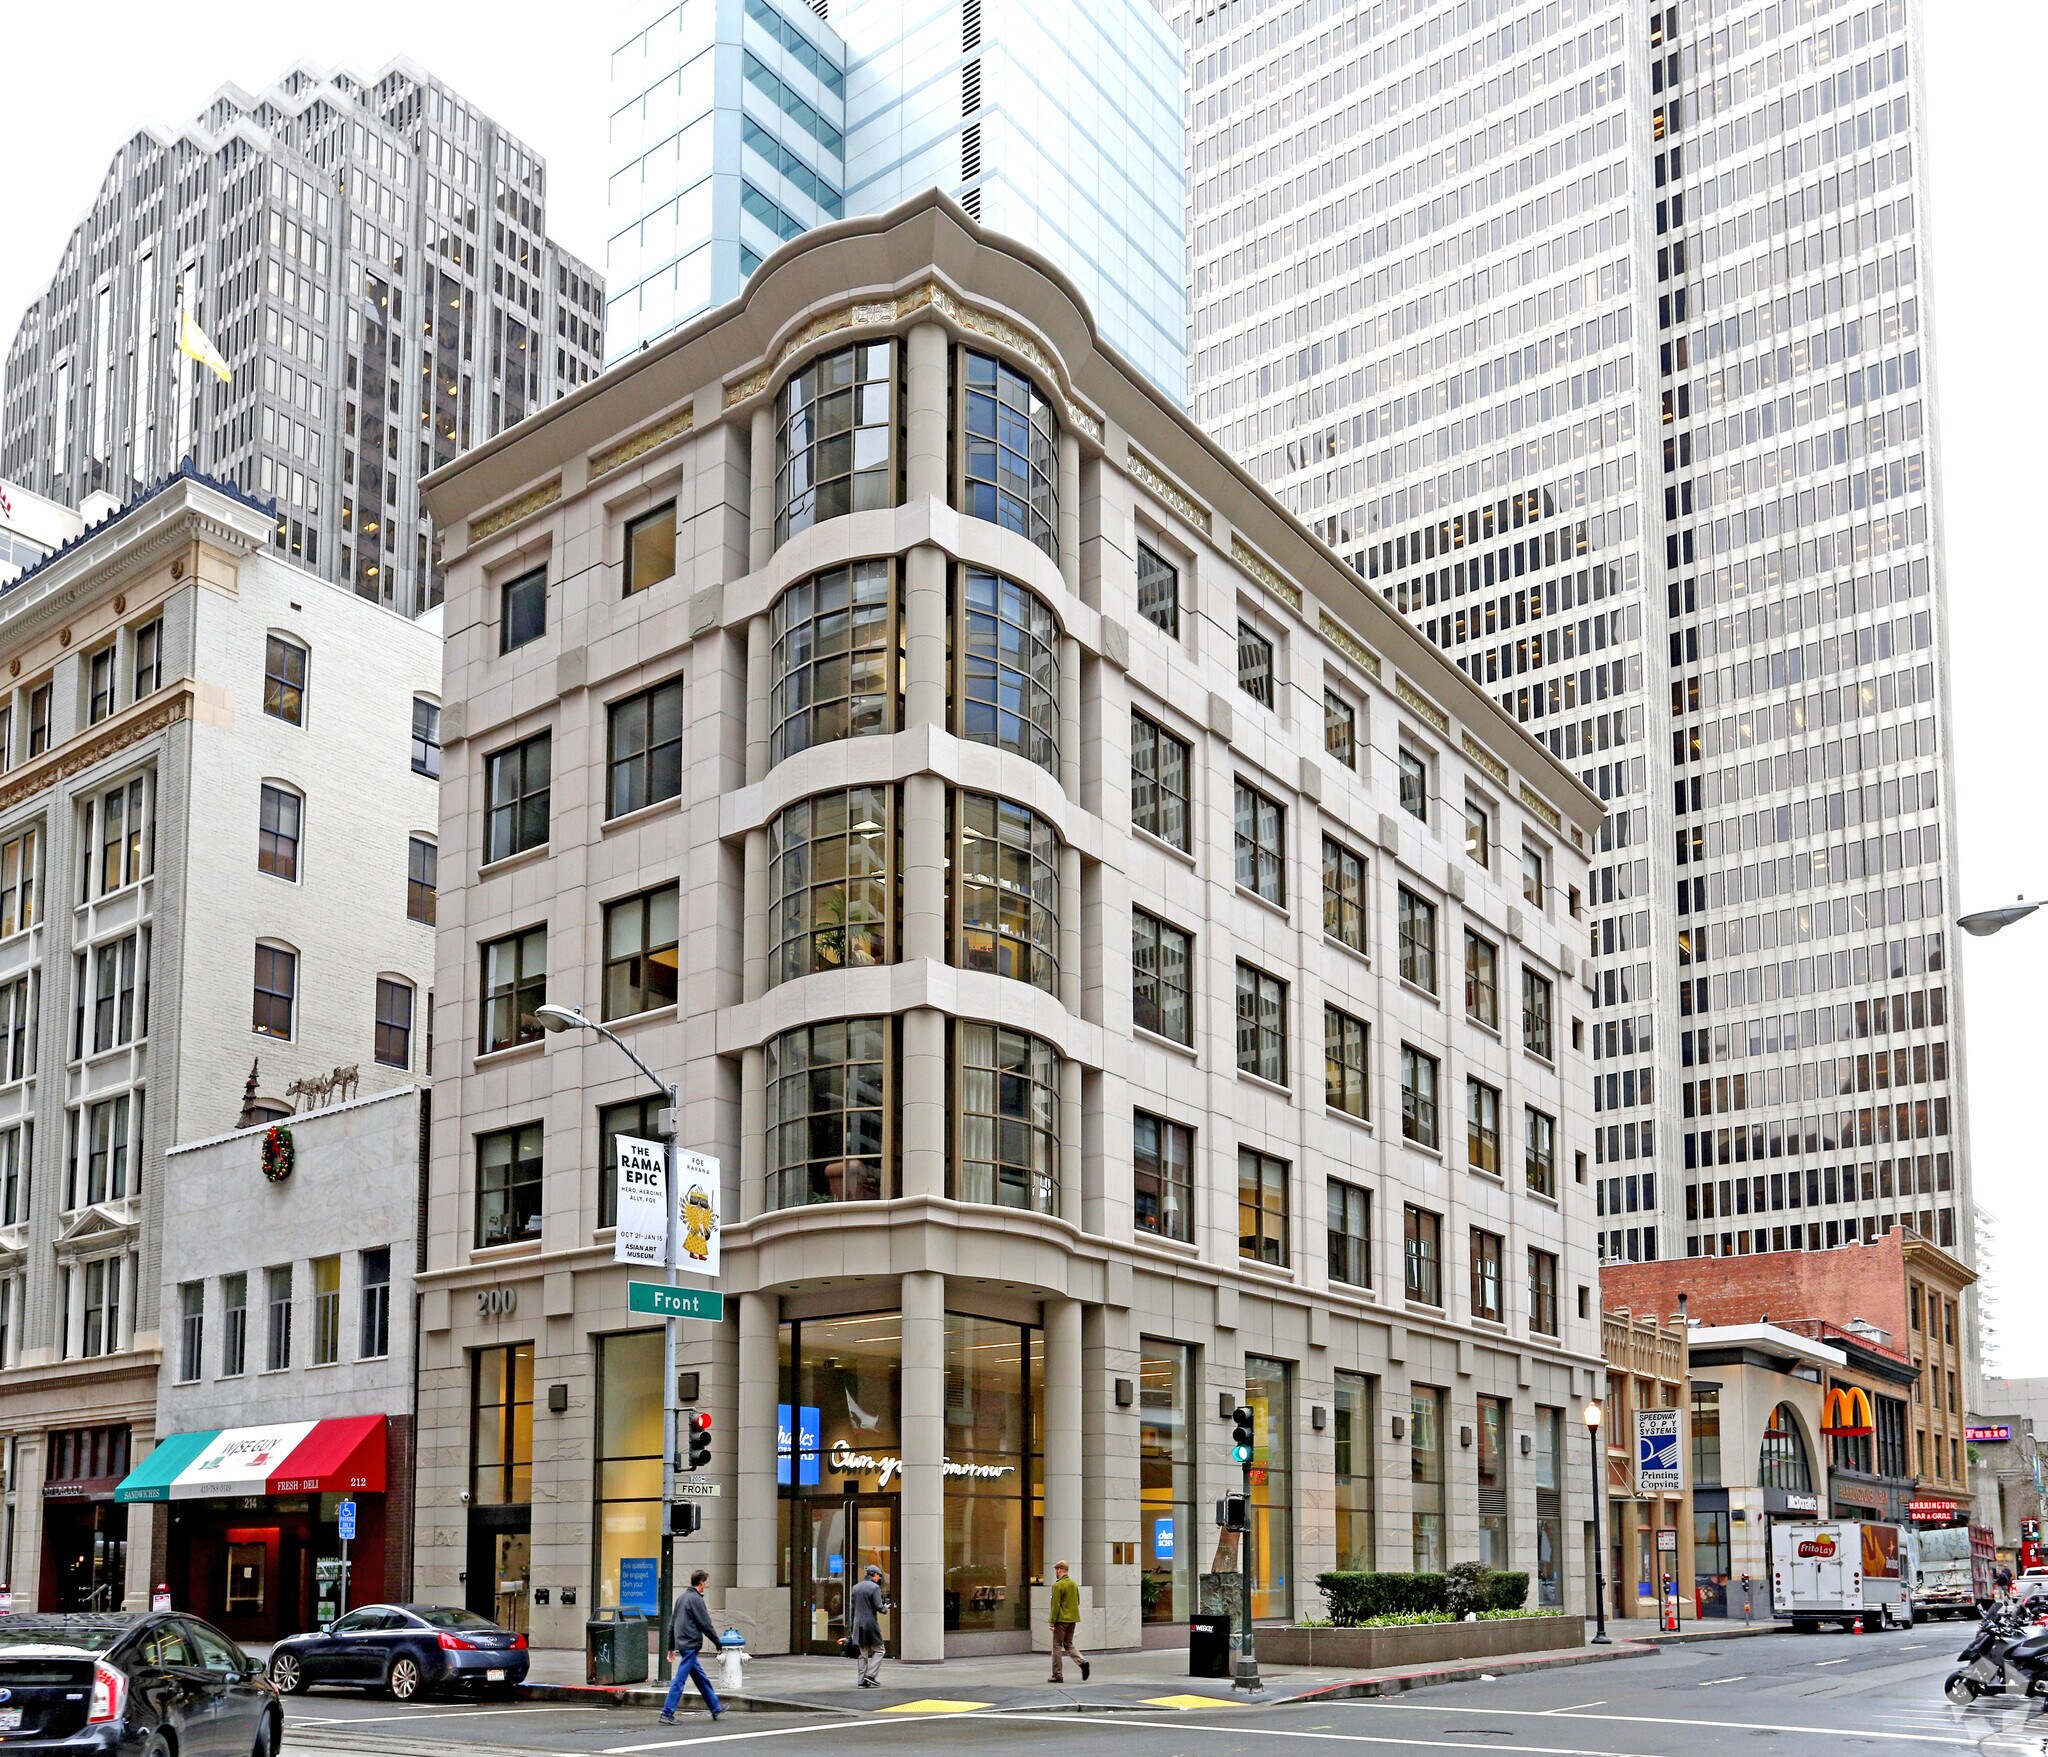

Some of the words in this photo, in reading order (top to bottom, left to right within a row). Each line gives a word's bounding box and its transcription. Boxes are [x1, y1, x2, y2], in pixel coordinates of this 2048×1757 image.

[631, 1145, 650, 1157] THE
[621, 1155, 662, 1173] RAMA
[692, 1157, 704, 1167] FOE
[687, 1165, 710, 1175] RAVANA
[626, 1170, 658, 1187] EPIC
[630, 1195, 645, 1203] ALLY,
[645, 1196, 656, 1204] FOE
[625, 1243, 644, 1252] ASIAN
[645, 1245, 657, 1253] ART
[627, 1251, 654, 1260] MUSEUM
[476, 1288, 517, 1316] 200
[654, 1291, 699, 1312] Front
[1639, 1412, 1677, 1421] SPEEDWAY
[1639, 1420, 1677, 1428] COPY
[1640, 1427, 1677, 1436] SYSTEMS
[1641, 1471, 1679, 1480] Printing
[277, 1480, 298, 1491] FRESH
[303, 1479, 319, 1489] DELI
[350, 1477, 366, 1487] 212
[1641, 1480, 1679, 1490] Copying
[124, 1488, 160, 1500] SANDWICHES
[682, 1485, 714, 1494] FRONT
[244, 1497, 257, 1509] 214
[1786, 1494, 1817, 1511] McDonald's
[1911, 1512, 1926, 1520] BAR
[1931, 1512, 1952, 1520] GRILL
[632, 1562, 654, 1570] questions.
[630, 1571, 649, 1580] engaged.
[622, 1580, 633, 1588] Own
[633, 1581, 644, 1589] your
[1195, 1624, 1214, 1632] WEEKLY
